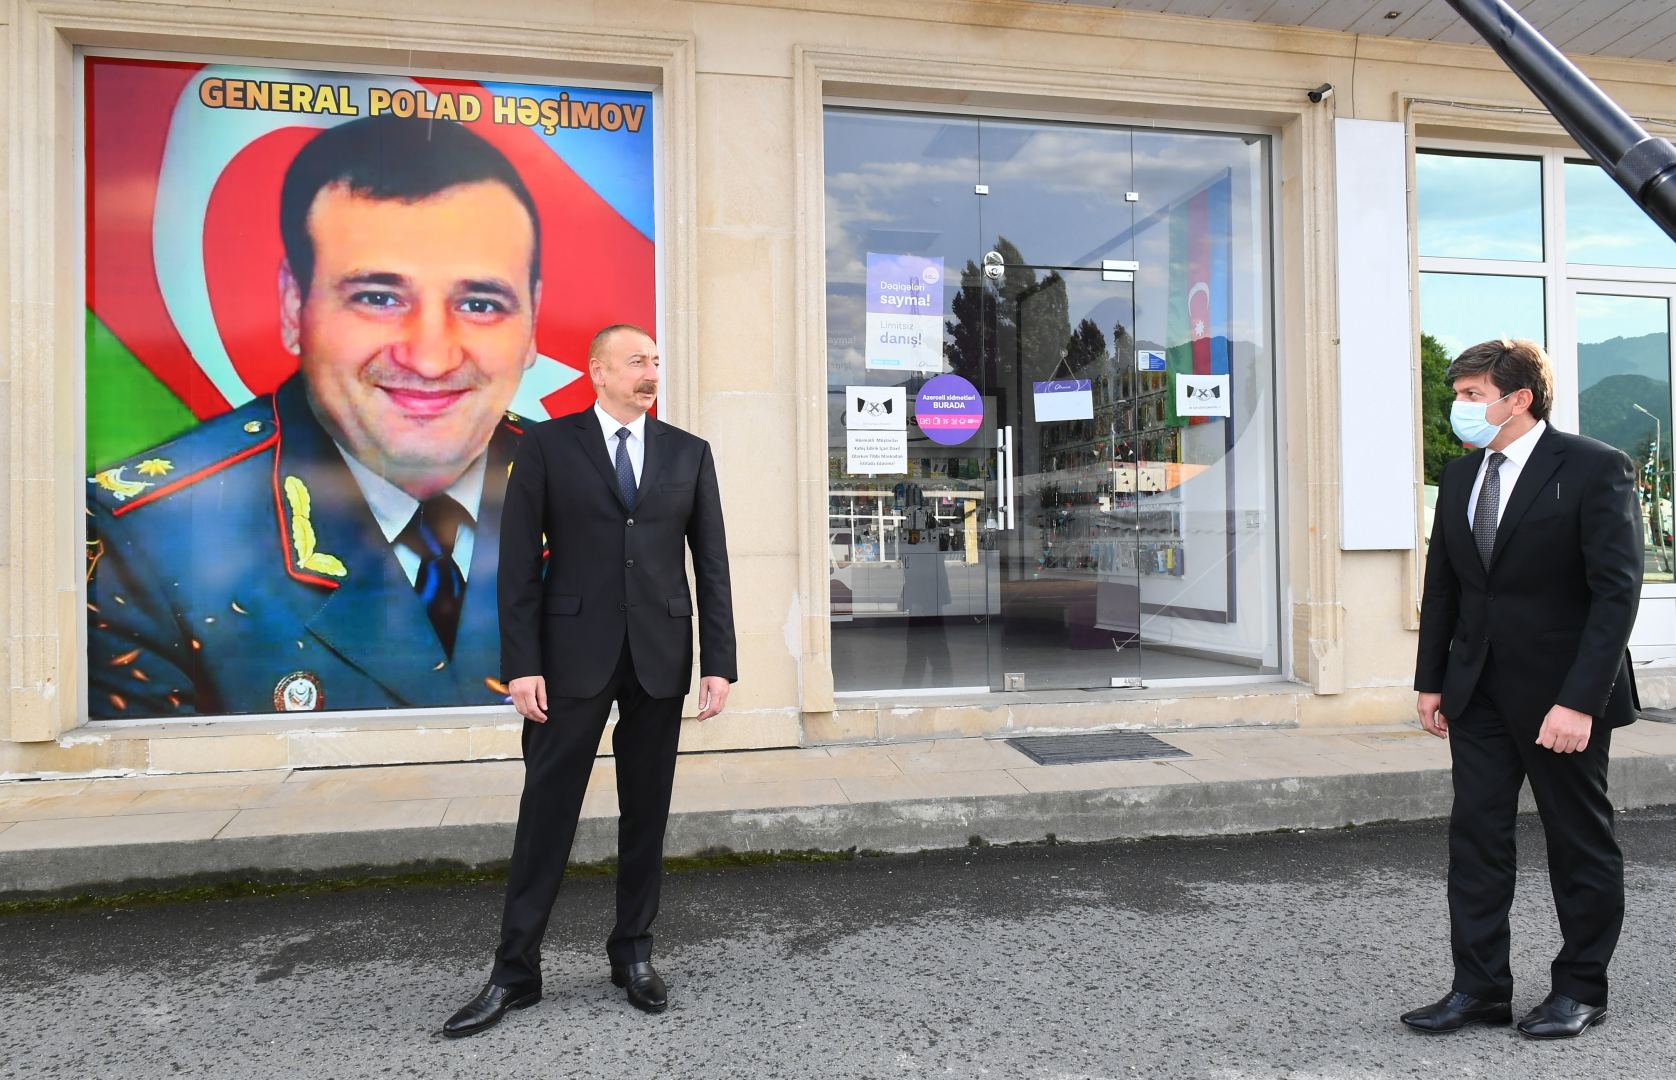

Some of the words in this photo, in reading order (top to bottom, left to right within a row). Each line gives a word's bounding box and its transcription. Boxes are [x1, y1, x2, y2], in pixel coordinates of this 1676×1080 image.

[198, 77, 359, 117] GENERAL
[368, 87, 482, 123] POLAD
[493, 93, 646, 136] HƏŞİMOV
[880, 294, 931, 308] sayma!
[880, 321, 914, 331] Limitsiz
[880, 332, 922, 348] danış!
